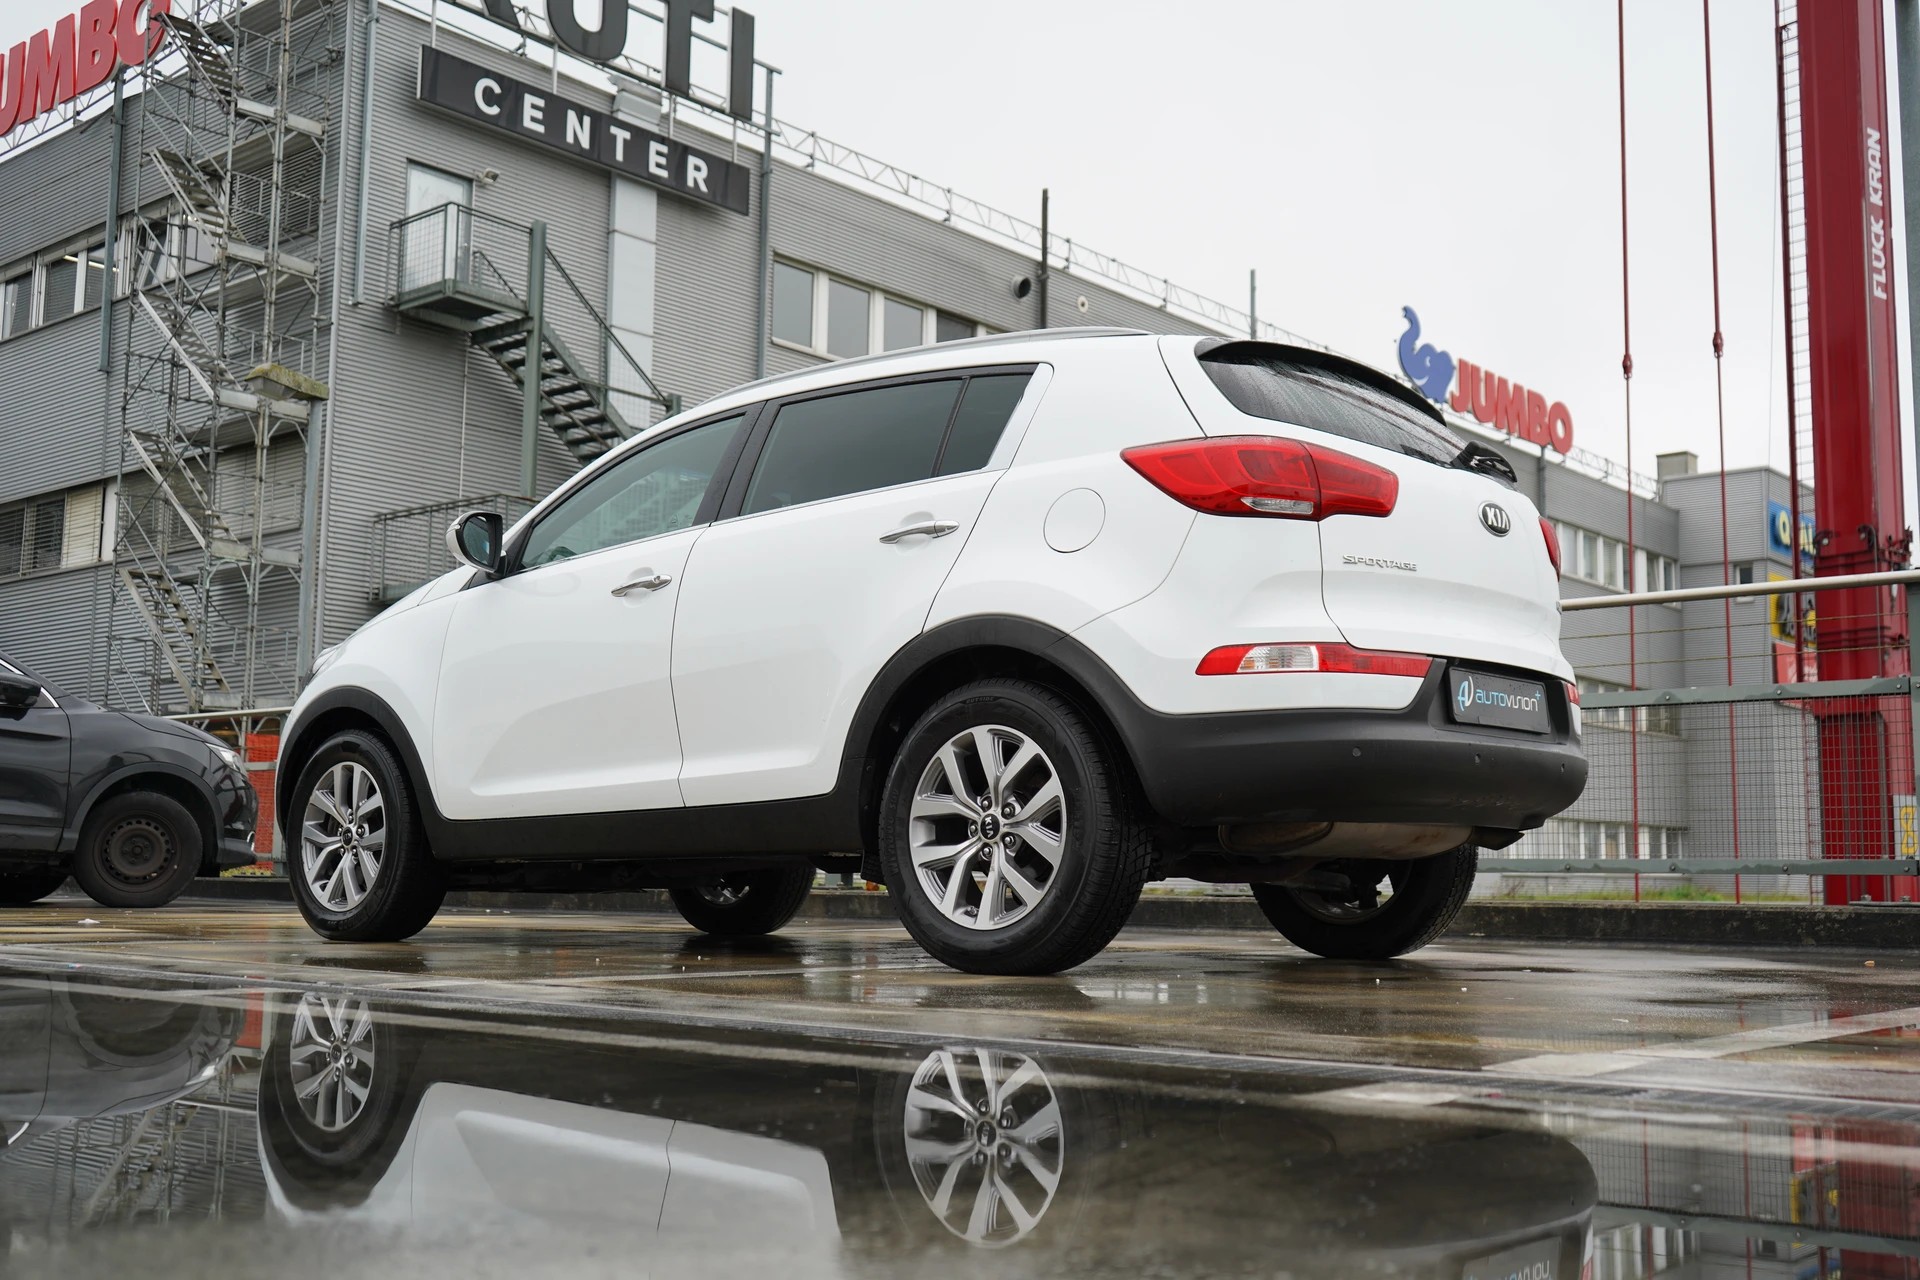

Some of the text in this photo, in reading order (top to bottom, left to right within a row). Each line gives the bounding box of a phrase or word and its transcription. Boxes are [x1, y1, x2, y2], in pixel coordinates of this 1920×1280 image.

[474, 77, 709, 193] CENTER
[1866, 127, 1888, 300] FLUCK KRAN
[1451, 357, 1574, 455] JUMBO
[1484, 505, 1510, 531] KIA
[1342, 554, 1418, 572] SPORTAGE
[984, 816, 994, 838] KIA
